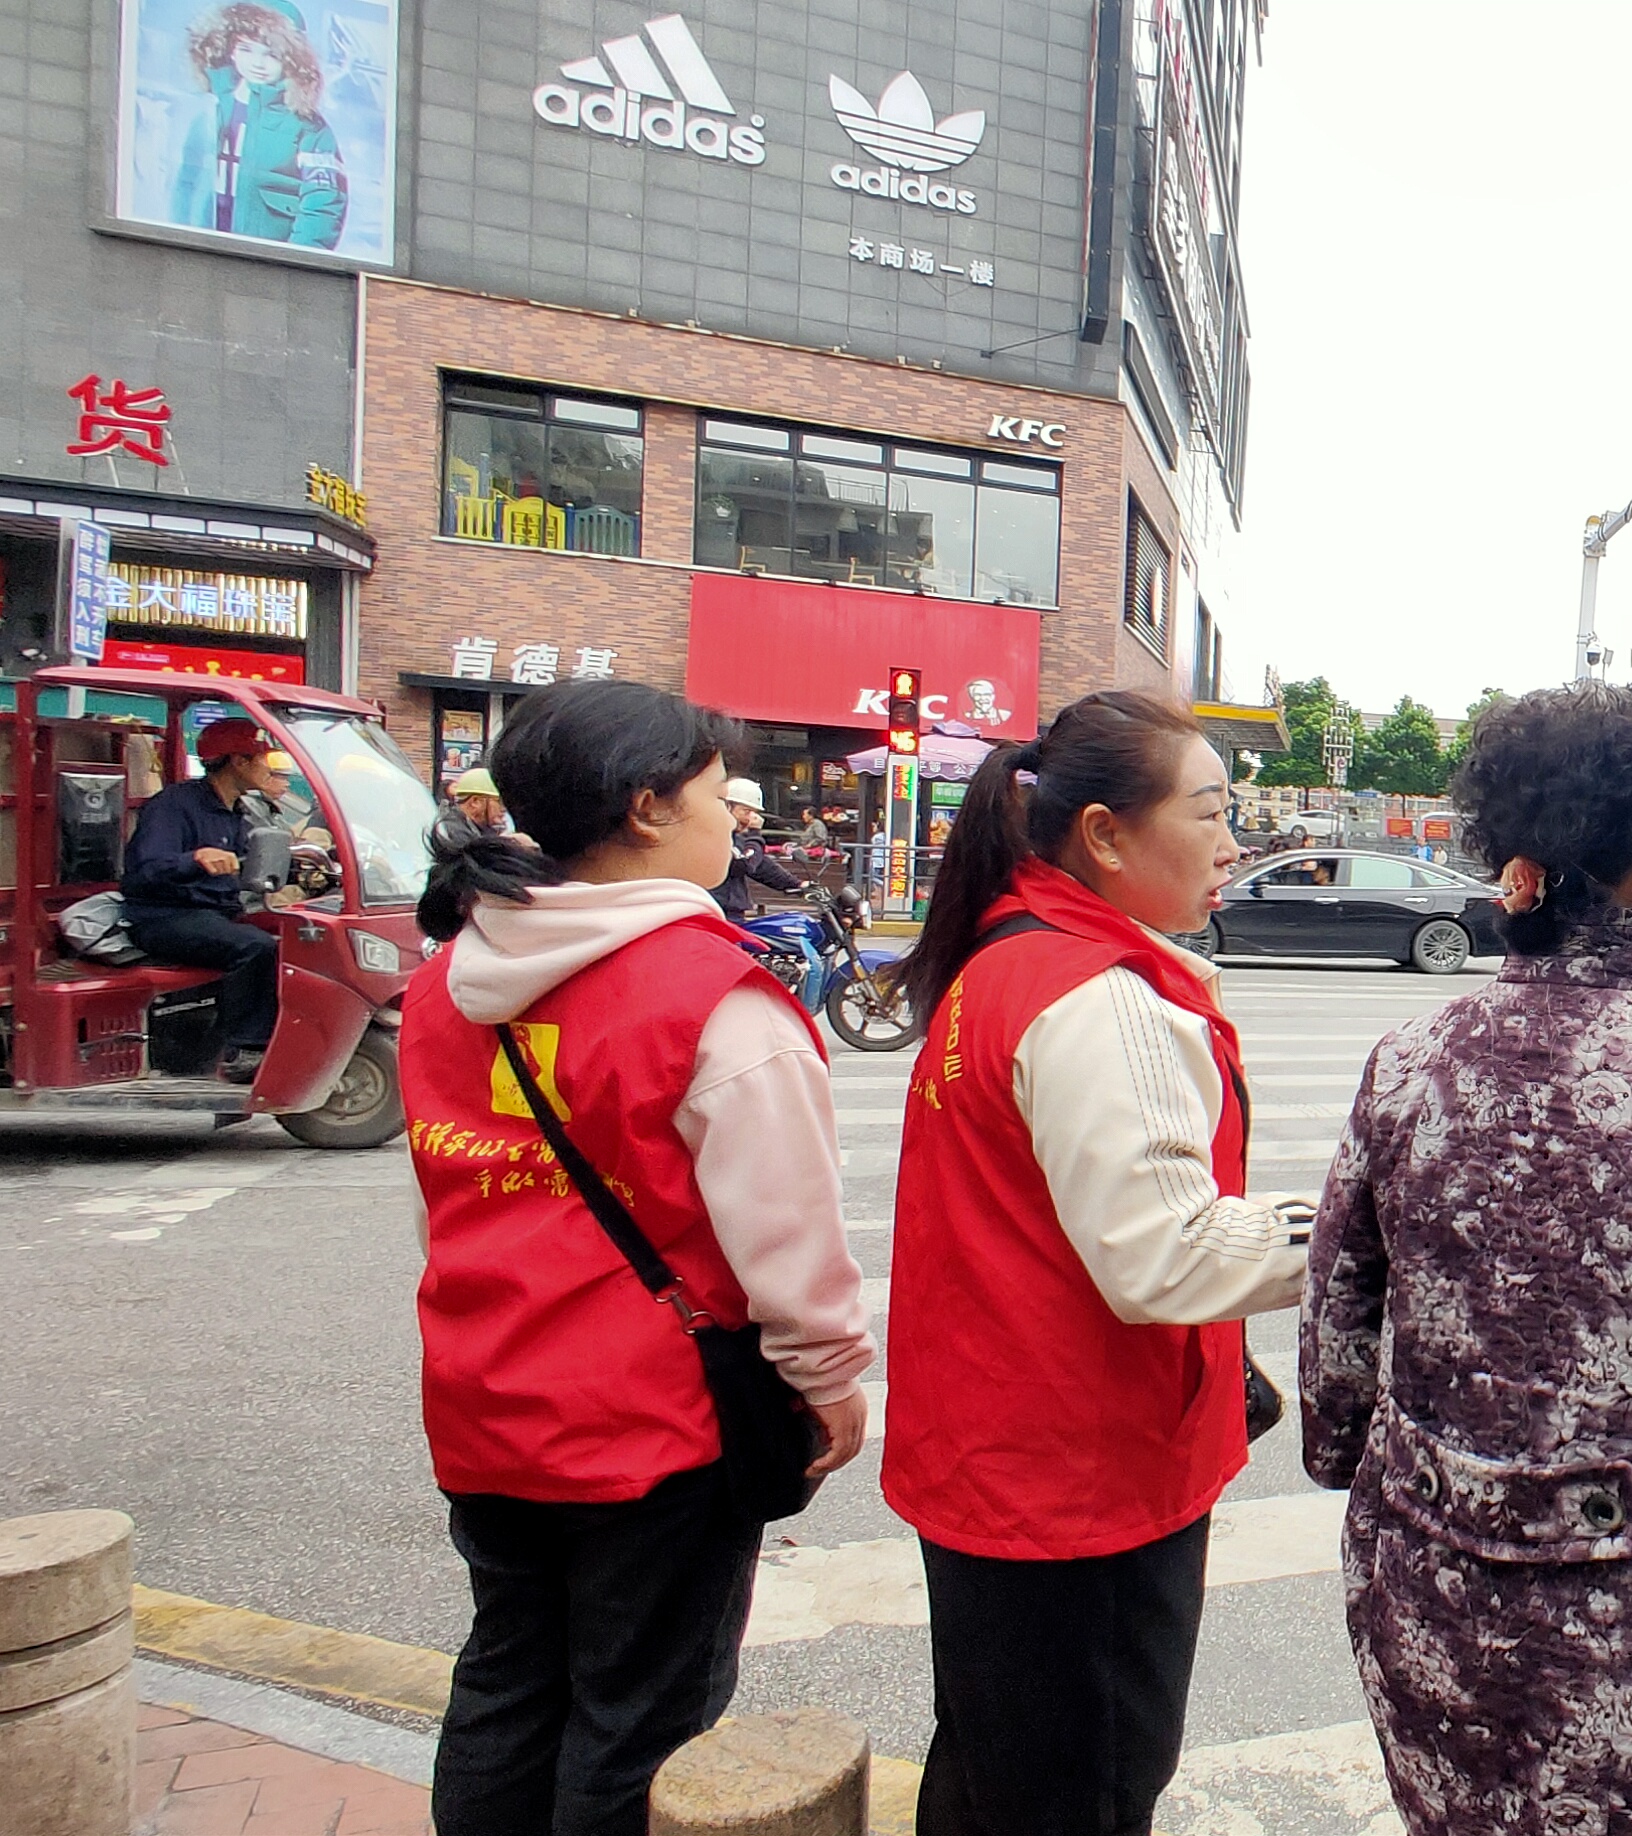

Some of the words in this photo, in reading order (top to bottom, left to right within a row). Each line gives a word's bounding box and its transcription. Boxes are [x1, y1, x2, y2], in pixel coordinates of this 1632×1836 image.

[533, 84, 767, 165] adidas
[831, 163, 978, 215] adidas
[849, 237, 995, 287] 本商场一楼
[66, 373, 173, 467] 货
[987, 414, 1067, 448] KFC
[451, 636, 618, 686] 肯德基
[853, 688, 948, 720] KC
